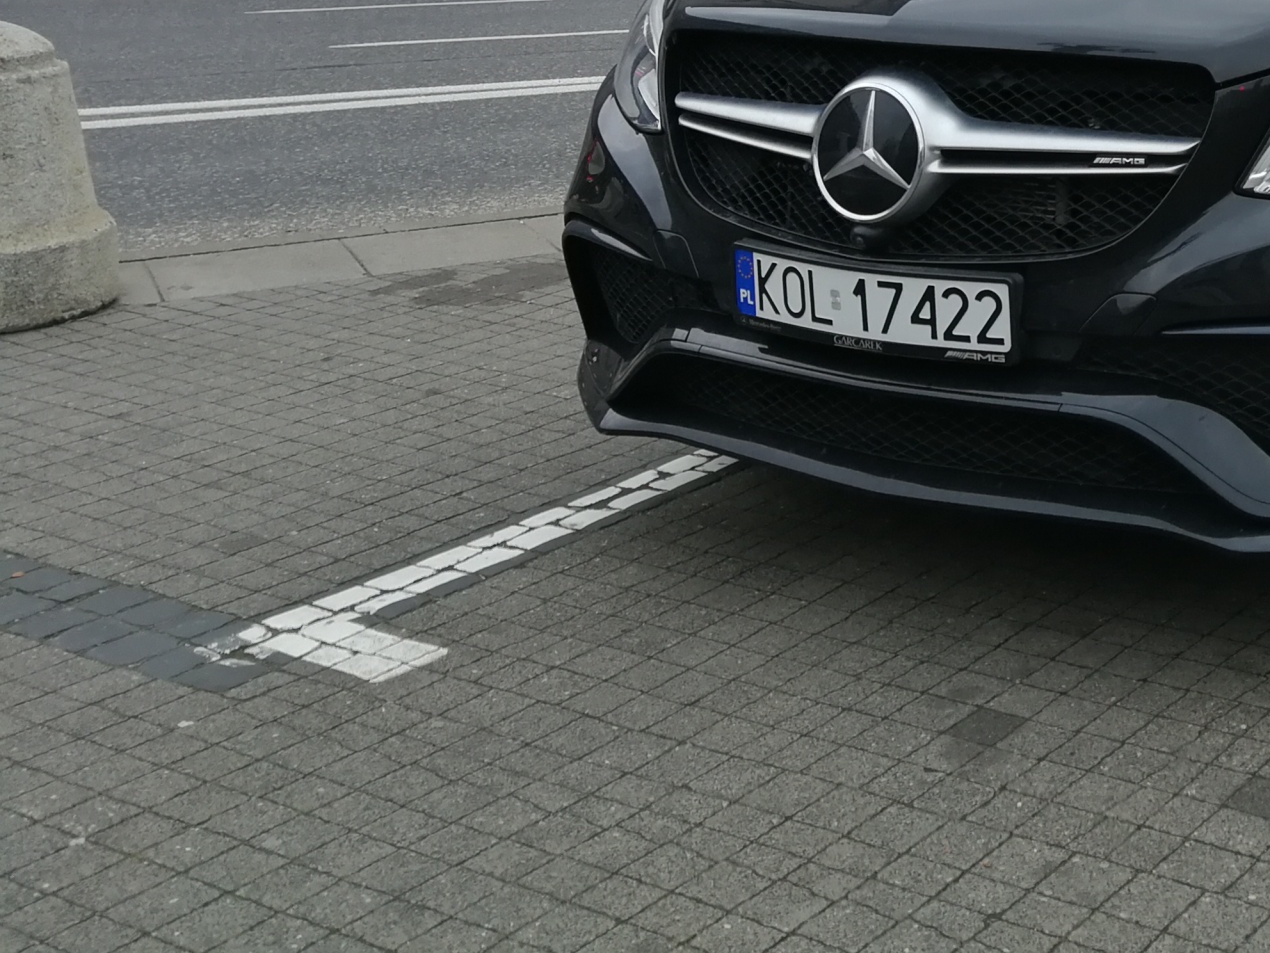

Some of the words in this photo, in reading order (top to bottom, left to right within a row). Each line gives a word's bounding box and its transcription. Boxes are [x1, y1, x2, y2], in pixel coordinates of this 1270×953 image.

[1109, 157, 1146, 165] AMG
[740, 287, 754, 305] PL
[756, 259, 833, 326] KOL
[852, 278, 1005, 346] 17422
[833, 334, 883, 352] GARCAREK
[963, 352, 1006, 363] AMG
